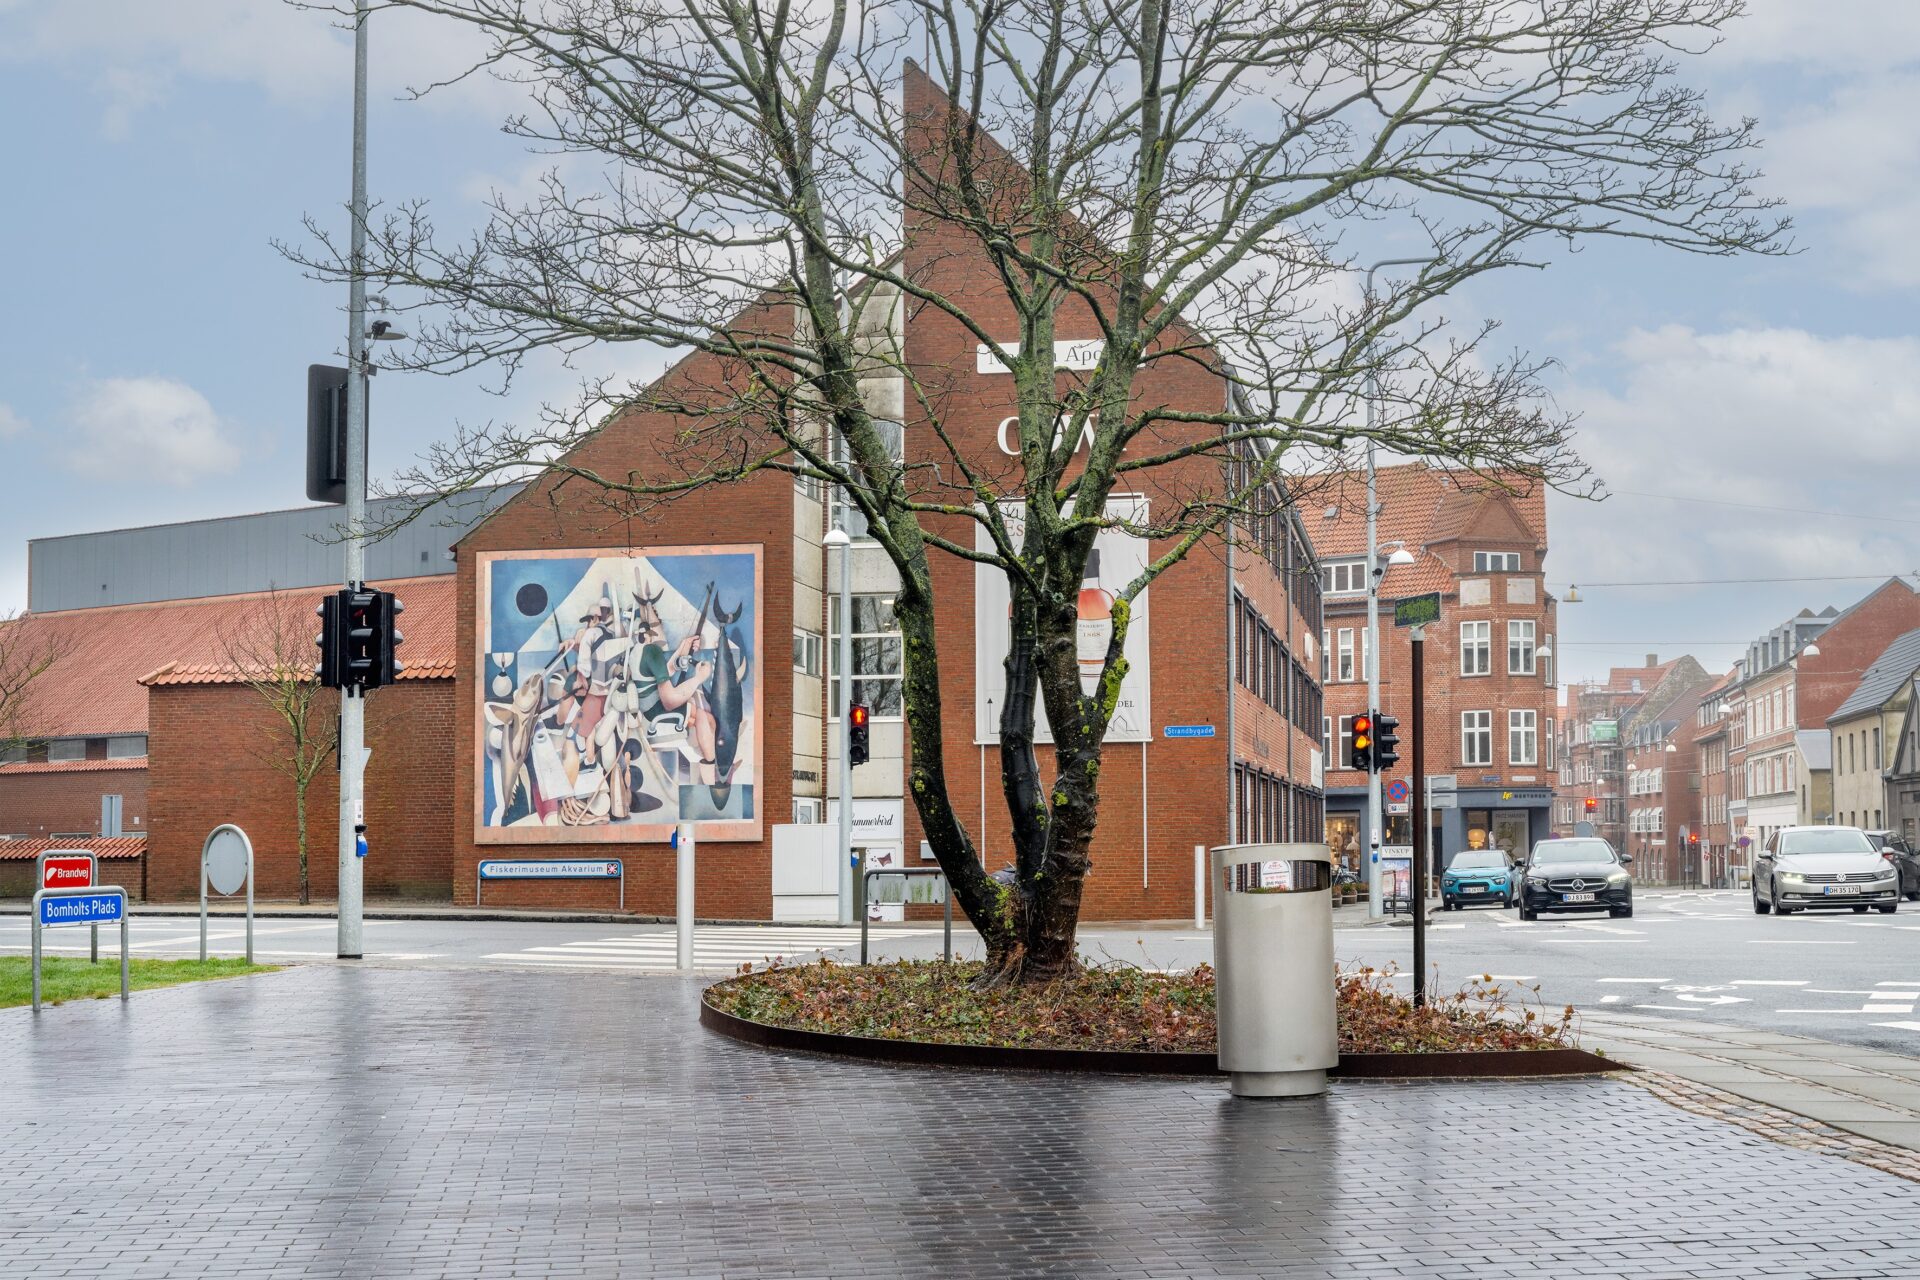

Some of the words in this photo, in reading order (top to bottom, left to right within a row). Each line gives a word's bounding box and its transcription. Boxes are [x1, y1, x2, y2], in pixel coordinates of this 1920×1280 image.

[1117, 700, 1135, 708] DEL
[1167, 727, 1213, 736] Strandbygade
[839, 813, 894, 827] ummerbird
[57, 867, 89, 880] Brandvej
[489, 865, 559, 873] Fiskerimuseum
[561, 865, 604, 873] Akvarium
[46, 901, 90, 918] Bomholts
[92, 899, 116, 915] Plads
